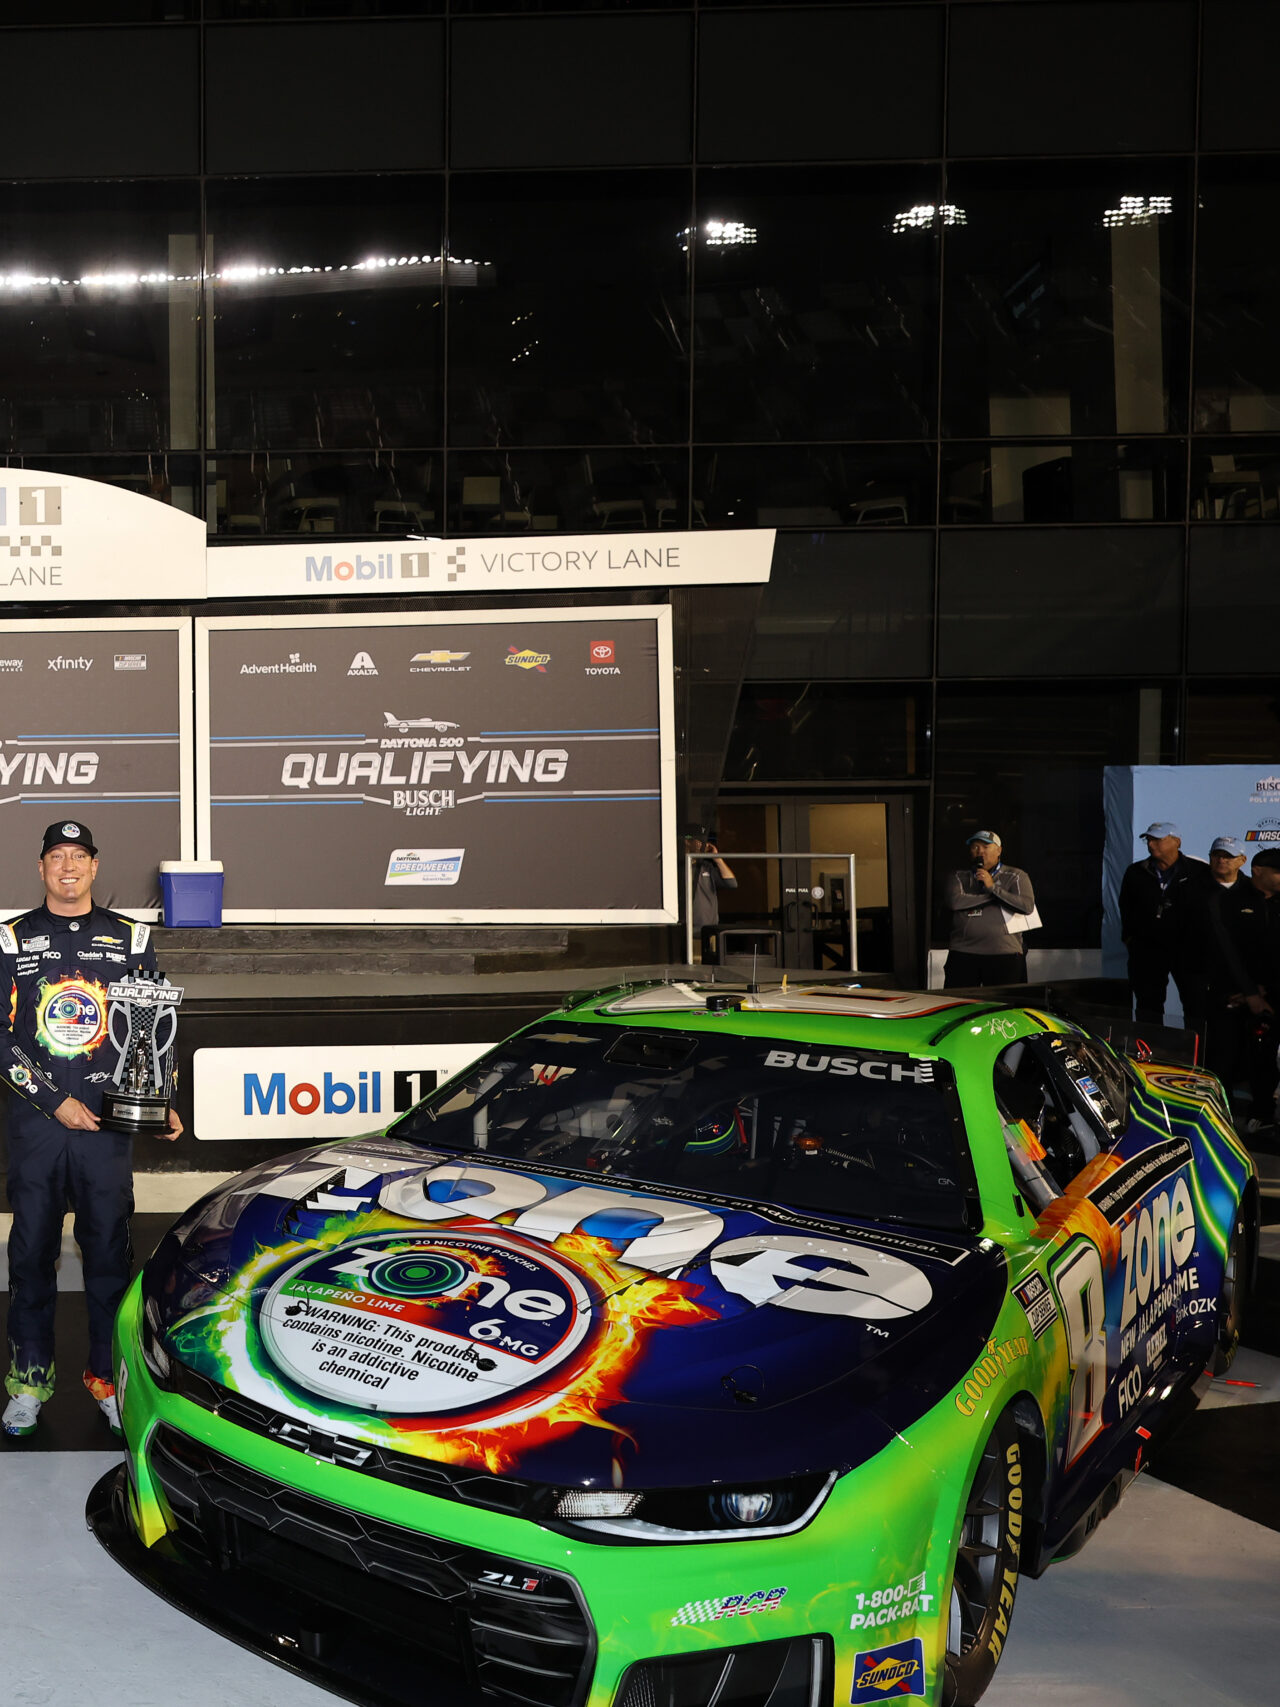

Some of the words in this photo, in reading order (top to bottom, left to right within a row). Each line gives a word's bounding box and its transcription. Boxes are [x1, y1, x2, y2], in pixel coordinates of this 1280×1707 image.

[305, 555, 393, 582] Mobil
[480, 550, 597, 574] VICTORY
[608, 547, 681, 570] LANE
[47, 656, 93, 671] xfinity
[239, 662, 317, 675] AdventHealth
[507, 655, 548, 664] SUNOCO
[585, 667, 621, 675] TOYOTA
[380, 738, 436, 749] DAYTONA
[439, 737, 464, 748] 500
[281, 749, 569, 789] QUALIFYING
[393, 790, 455, 808] BUSCH
[405, 807, 441, 816] LIGHT
[394, 863, 455, 871] SPEEDWEEKS
[43, 951, 62, 960] FICO
[111, 987, 179, 1000] QUALIFYING
[764, 1049, 922, 1085] BUSCH
[243, 1071, 381, 1116] Mobil
[506, 1161, 568, 1177] contains
[569, 1171, 634, 1189] nicotine.
[640, 1183, 707, 1201] Nicotine
[730, 1200, 754, 1210] an
[757, 1204, 842, 1233] addictive
[845, 1227, 941, 1255] chemical.
[415, 1239, 431, 1247] 20
[434, 1239, 493, 1252] NICOTINE
[491, 1247, 541, 1272] POUCHES
[1120, 1177, 1197, 1334] zone
[288, 1281, 367, 1305] JALAPEÑO
[369, 1297, 406, 1314] LIME
[327, 1247, 567, 1321] zone
[1188, 1297, 1217, 1315] OZK
[282, 1315, 343, 1341] contains
[342, 1331, 406, 1359] nicotine.
[410, 1350, 480, 1383] Nicotine
[303, 1304, 382, 1334] WARNING:
[383, 1322, 417, 1343] This
[418, 1336, 480, 1365] product
[1120, 1322, 1138, 1365] NEW
[1146, 1322, 1168, 1368] REBEL
[311, 1338, 326, 1353] is
[327, 1344, 347, 1360] an
[347, 1349, 420, 1382] addictive
[318, 1359, 391, 1391] chemical
[954, 1336, 1030, 1417] GOODYEAR
[1118, 1363, 1143, 1419] FICO
[987, 1442, 1024, 1665] GOODYEAR
[477, 1569, 540, 1592] ZL1
[714, 1586, 788, 1621] RCR
[859, 1662, 915, 1688] SUNOCO
